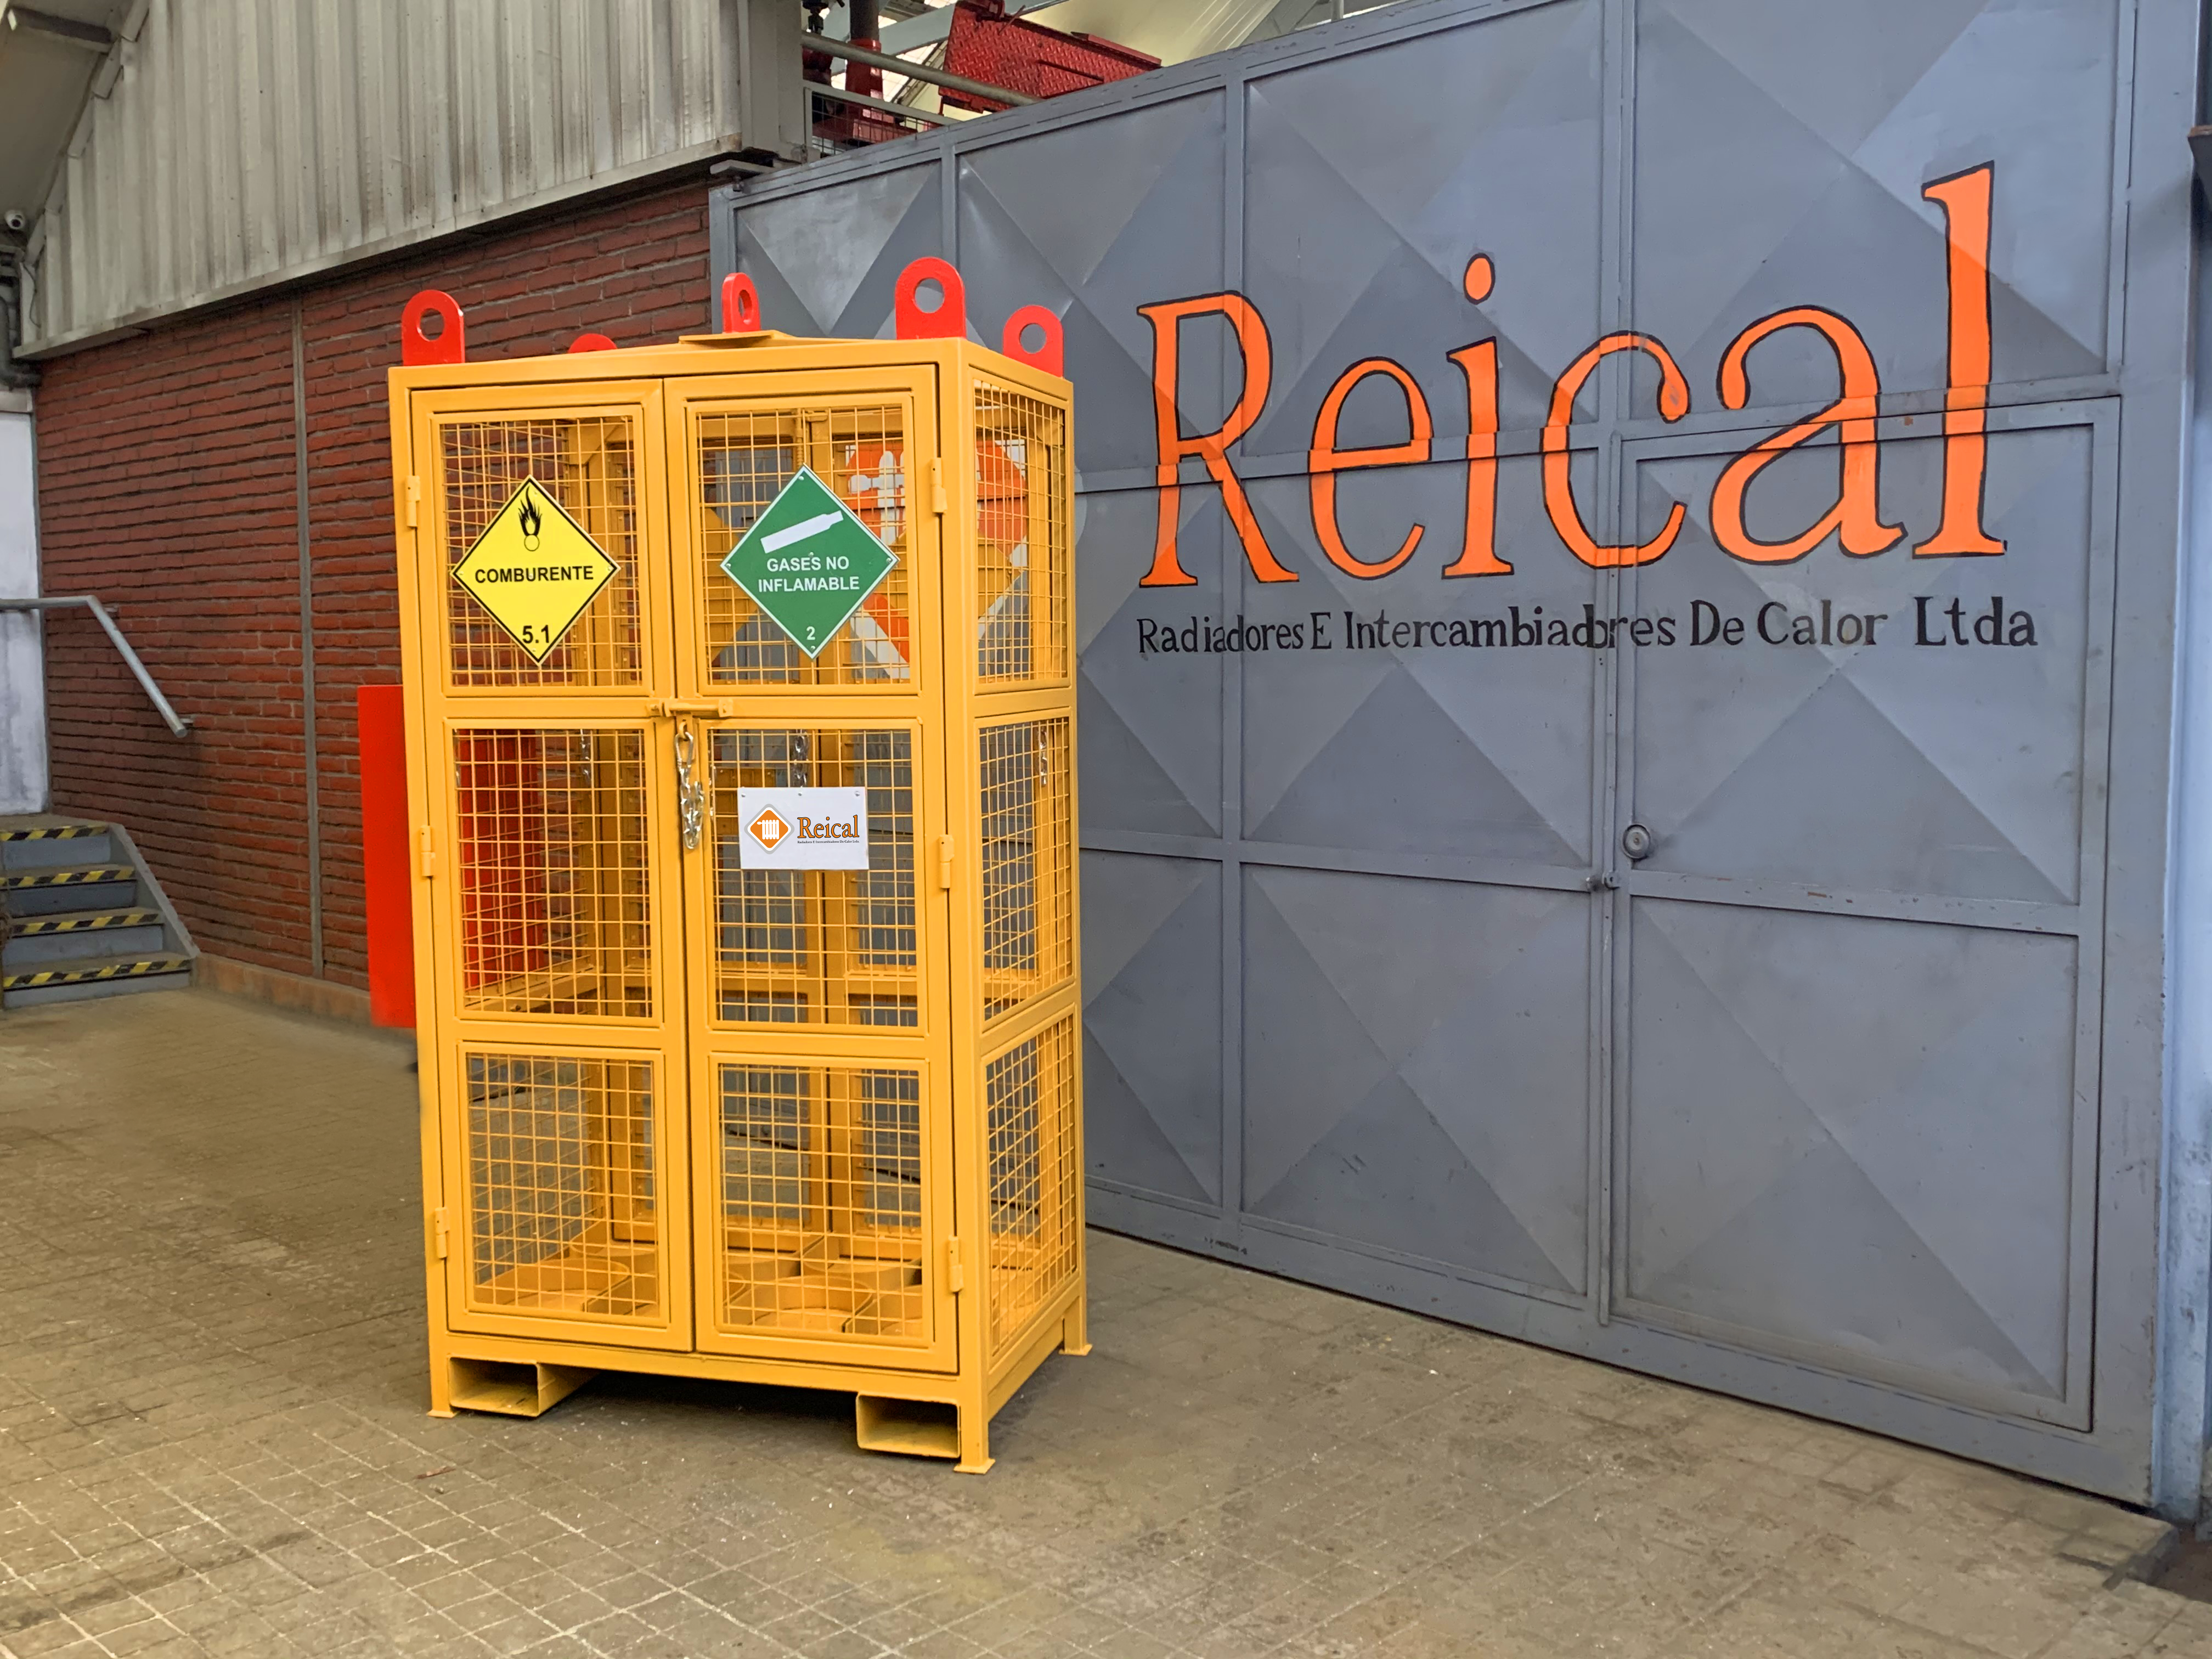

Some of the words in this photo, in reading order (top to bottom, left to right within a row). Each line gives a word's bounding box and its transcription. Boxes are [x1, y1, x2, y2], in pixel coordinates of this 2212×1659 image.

[1136, 160, 2007, 588] Reical
[766, 556, 821, 572] GASES
[826, 555, 849, 571] NO
[475, 566, 594, 583] COMBURENTE
[758, 576, 860, 592] INFLAMABLE
[806, 626, 816, 640] 2
[1137, 615, 1304, 653] Radiadores
[1310, 612, 1333, 651] E
[1345, 603, 1677, 650] Intercambiadores
[1690, 599, 1745, 646] De
[1757, 599, 1888, 646] Calor
[1914, 596, 2039, 647] Ltda
[522, 624, 550, 644] 5.1
[797, 814, 860, 838] Reical
